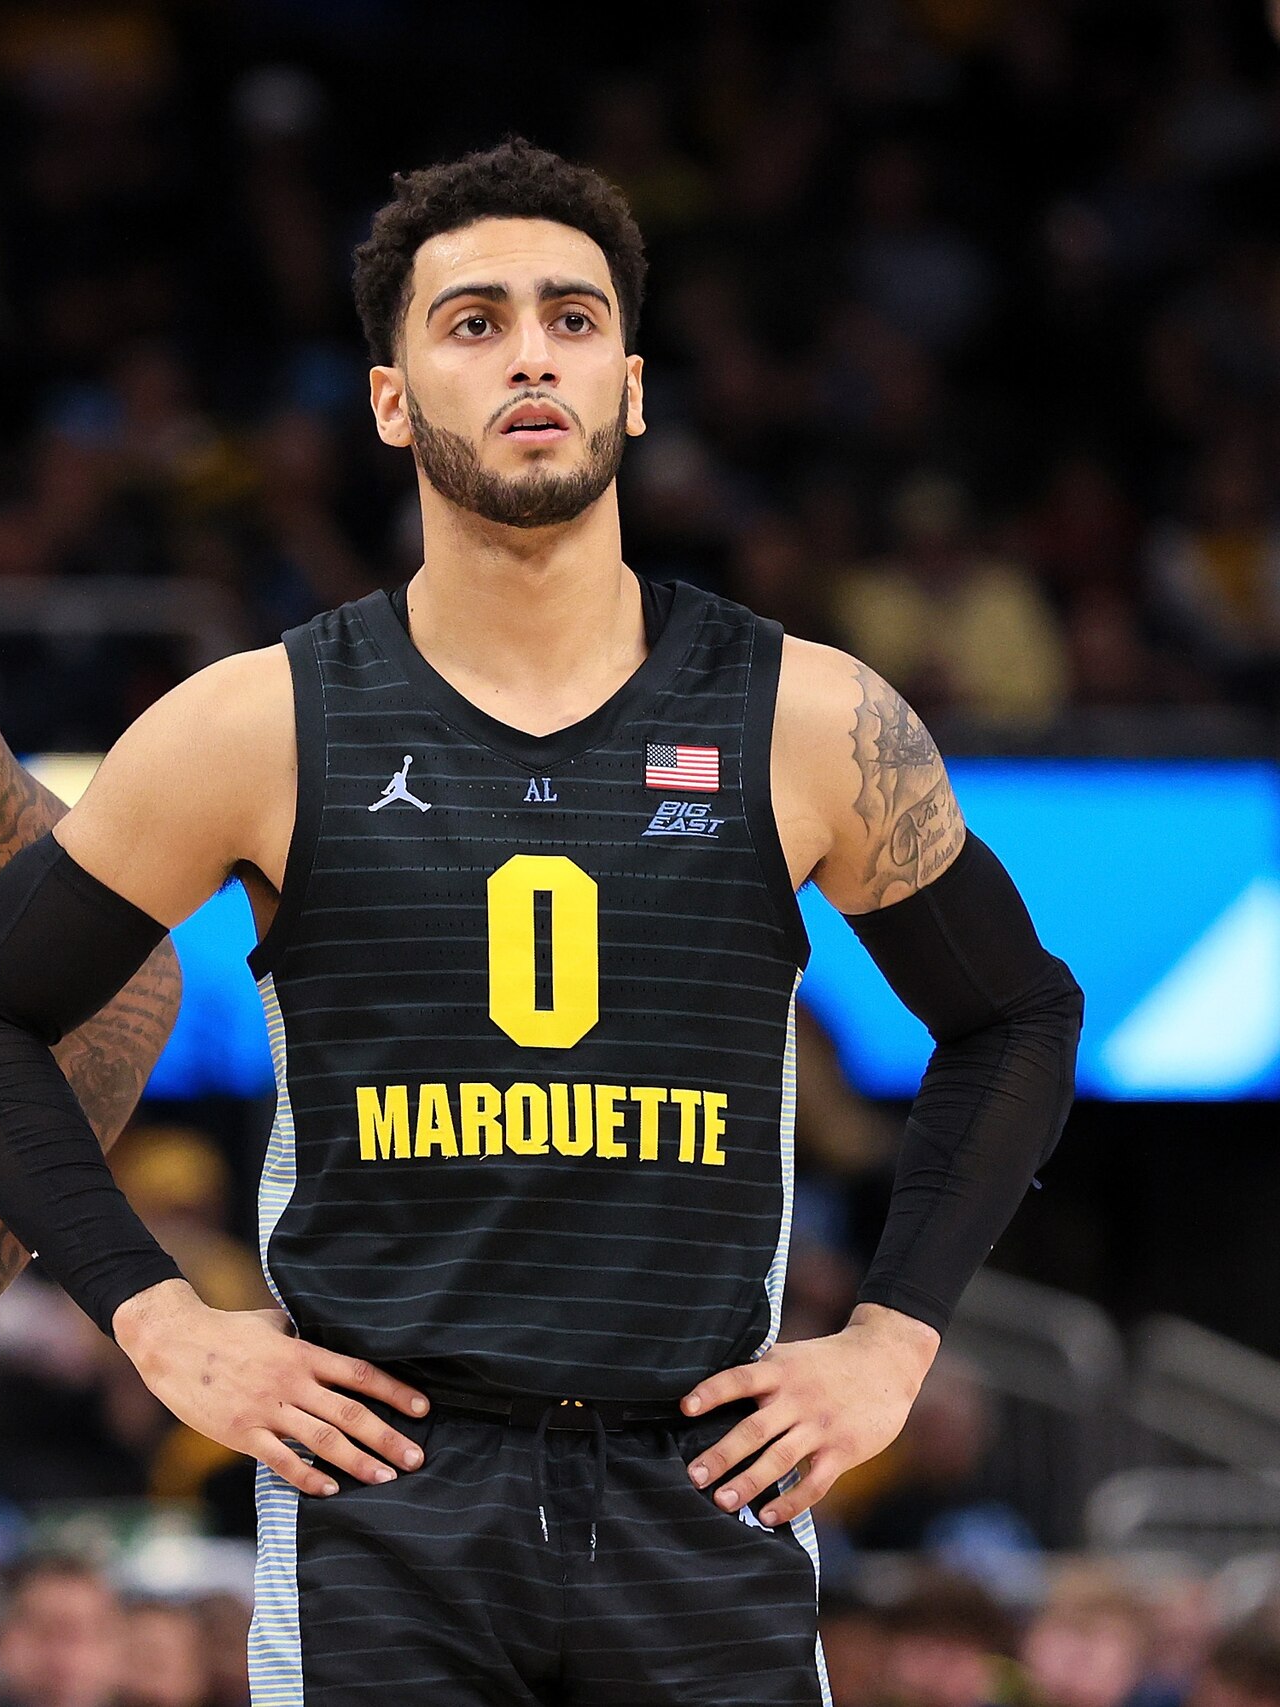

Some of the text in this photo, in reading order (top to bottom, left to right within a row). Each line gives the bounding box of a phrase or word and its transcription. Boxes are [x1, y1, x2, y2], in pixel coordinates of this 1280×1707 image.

[523, 777, 558, 802] AL
[656, 801, 712, 817] BIG
[648, 817, 724, 833] EAST
[487, 854, 599, 1048] 0
[356, 1082, 728, 1166] MARQUETTE
